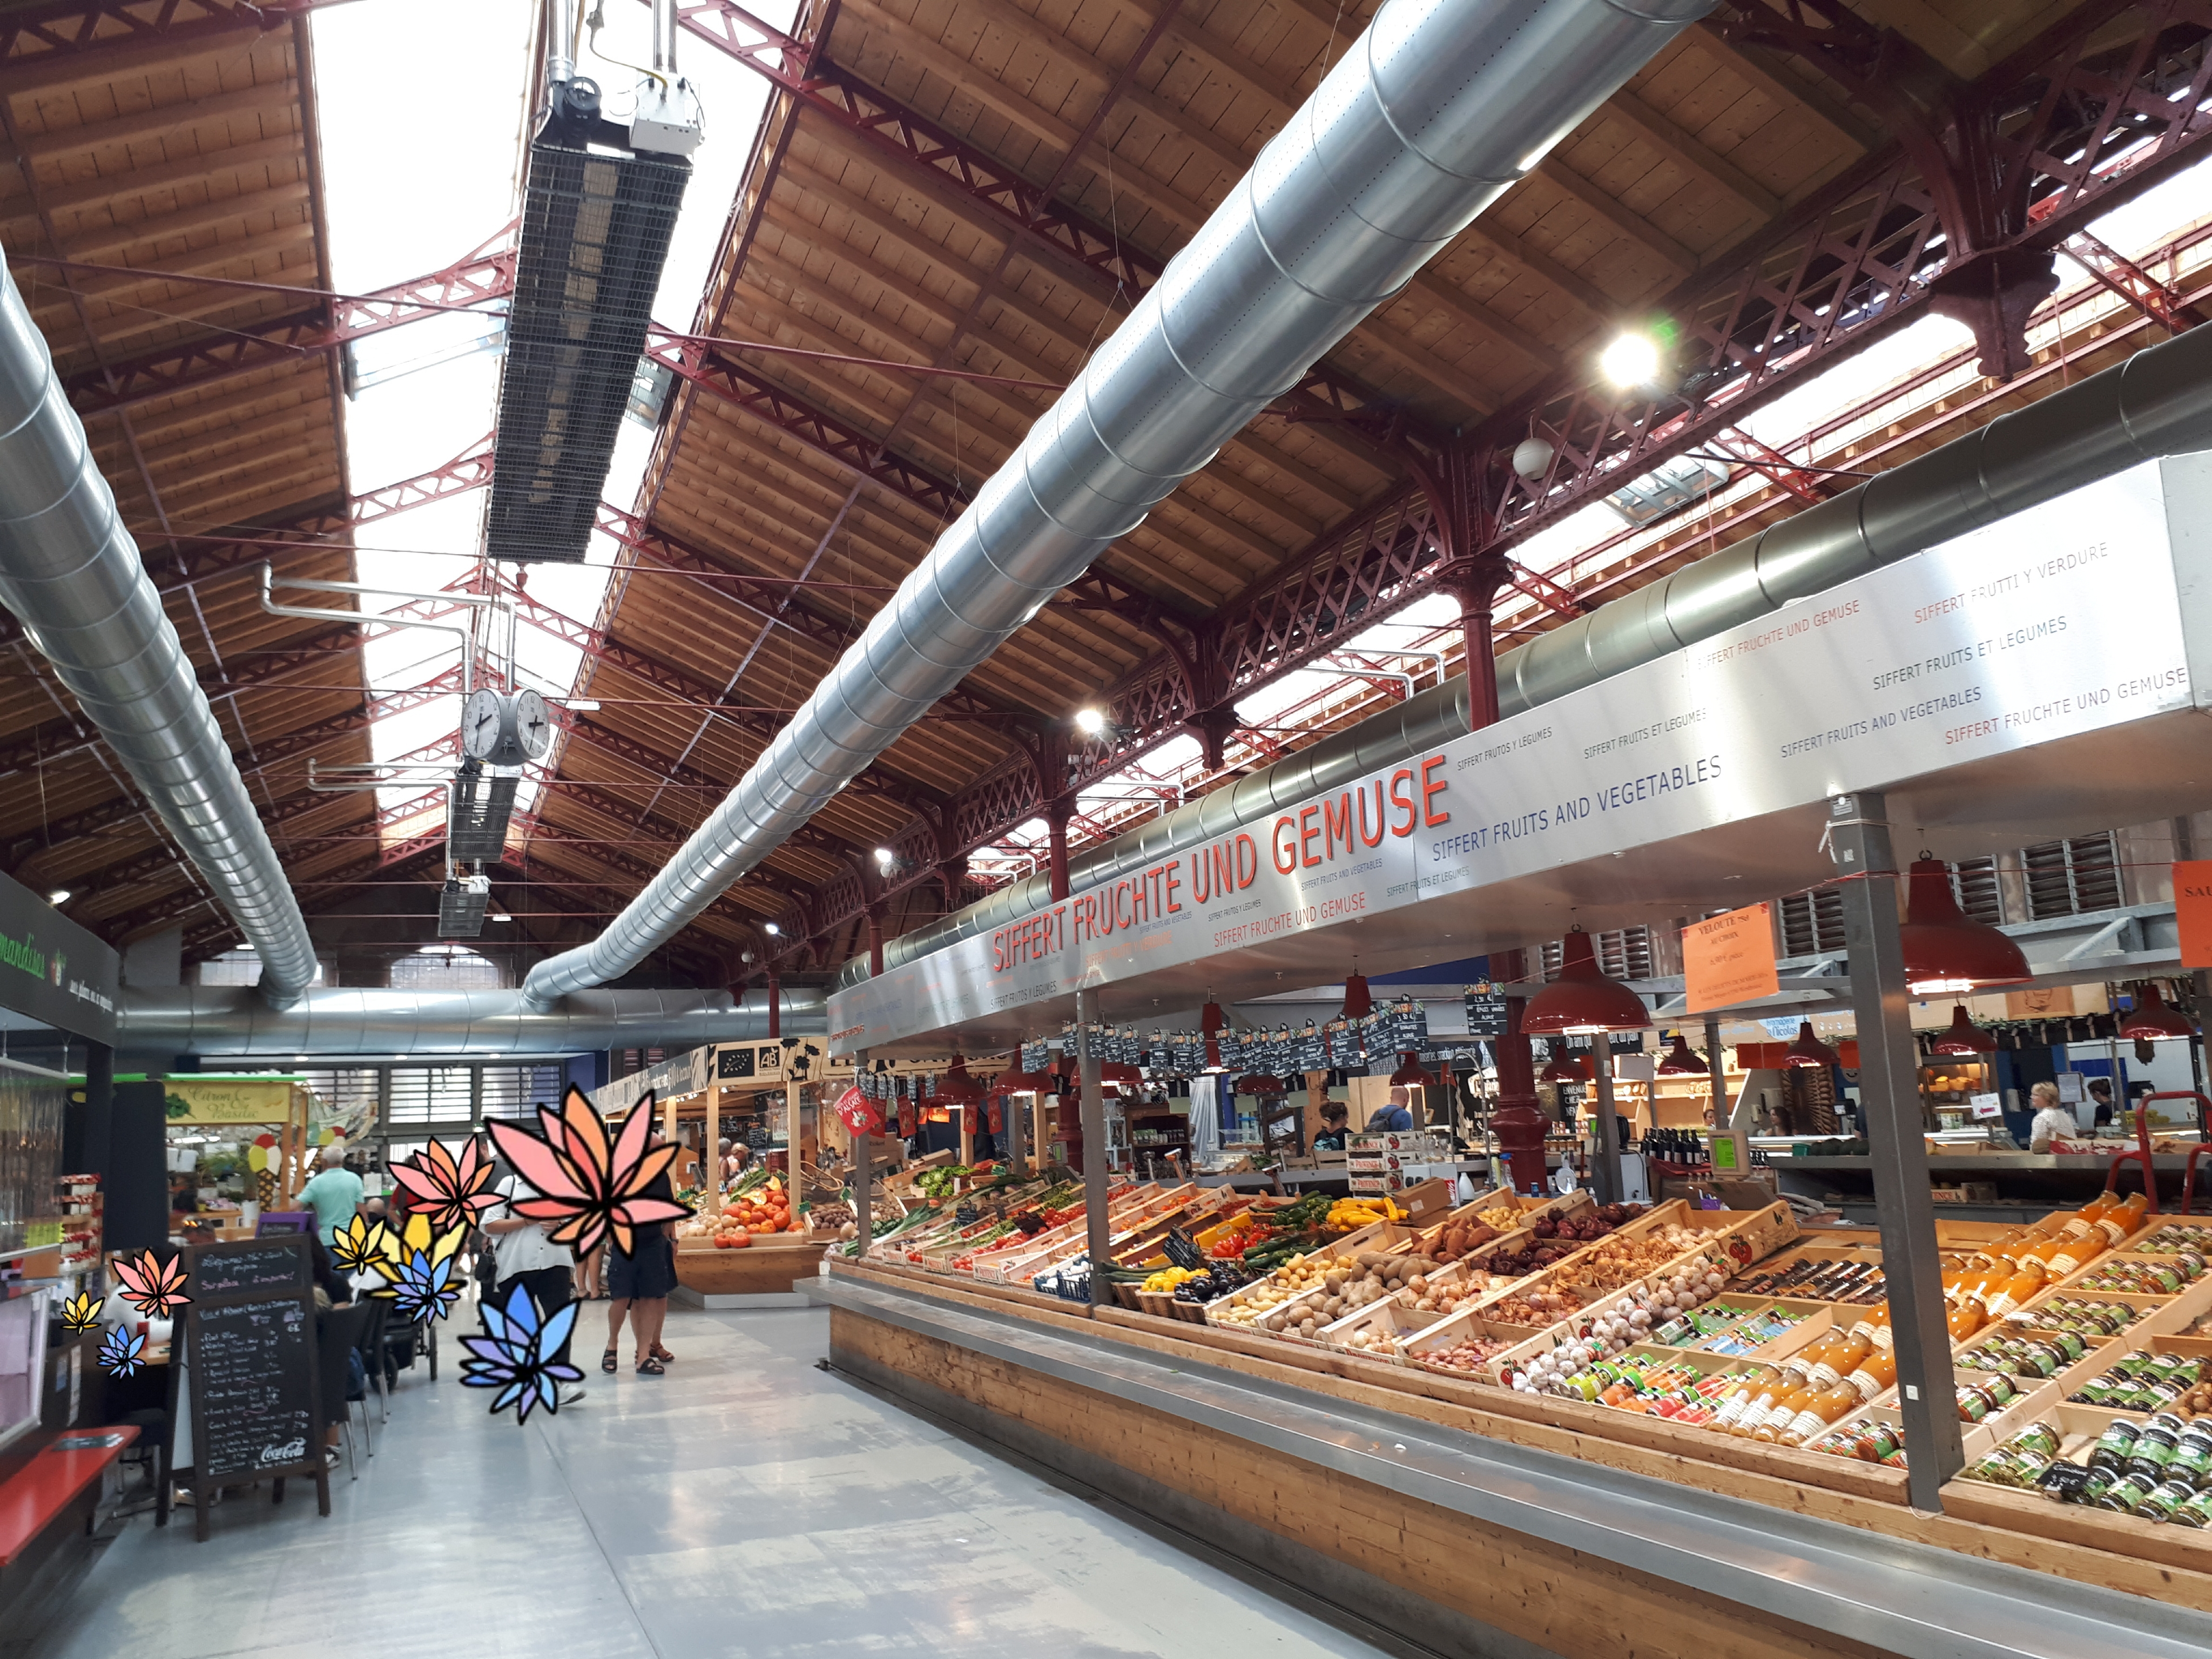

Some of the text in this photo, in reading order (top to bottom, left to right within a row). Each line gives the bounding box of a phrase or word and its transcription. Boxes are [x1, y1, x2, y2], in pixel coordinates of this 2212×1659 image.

[1914, 542, 2108, 623] SIFFERT FRUTTI Y VERDURE
[1698, 600, 1860, 670] SFFERT FRUCHTE UND GEMUSE
[1873, 616, 2067, 690] SIFFERT FRUITS ET LEGUMES
[1781, 687, 1982, 758] SIFFERT FRUITS AND VEGETABLES
[1945, 667, 2187, 745] SIFFERT FRUCHTE UND GEMUSE
[1457, 727, 1552, 771] SIFFERT FRUTOS Y LEGUMES
[1584, 708, 1706, 759] SIFFERT FRUITS ET LEGUMES
[1432, 755, 1722, 861] SIFFERT FRUITS AND VEGETABLES
[993, 754, 1449, 972] SIFFERT FRUCHTE UND GEMUSE
[1301, 858, 1382, 891] SIFFERT FRUITS AND VEGETABLES
[1386, 866, 1469, 897] SIFFERT FRUITS ET LEGUMES
[1208, 910, 1223, 922] SIFFERT
[1223, 906, 1239, 917] FRUTOS
[1243, 899, 1261, 912] LEGUMES
[1214, 892, 1366, 947] SIFFERT FRUCHTE UND GEMUSE
[990, 981, 1057, 1009] SIFFERT FRUTOS Y LEGUMES
[1772, 1025, 1798, 1037] Nicolas
[761, 1053, 777, 1067] AB
